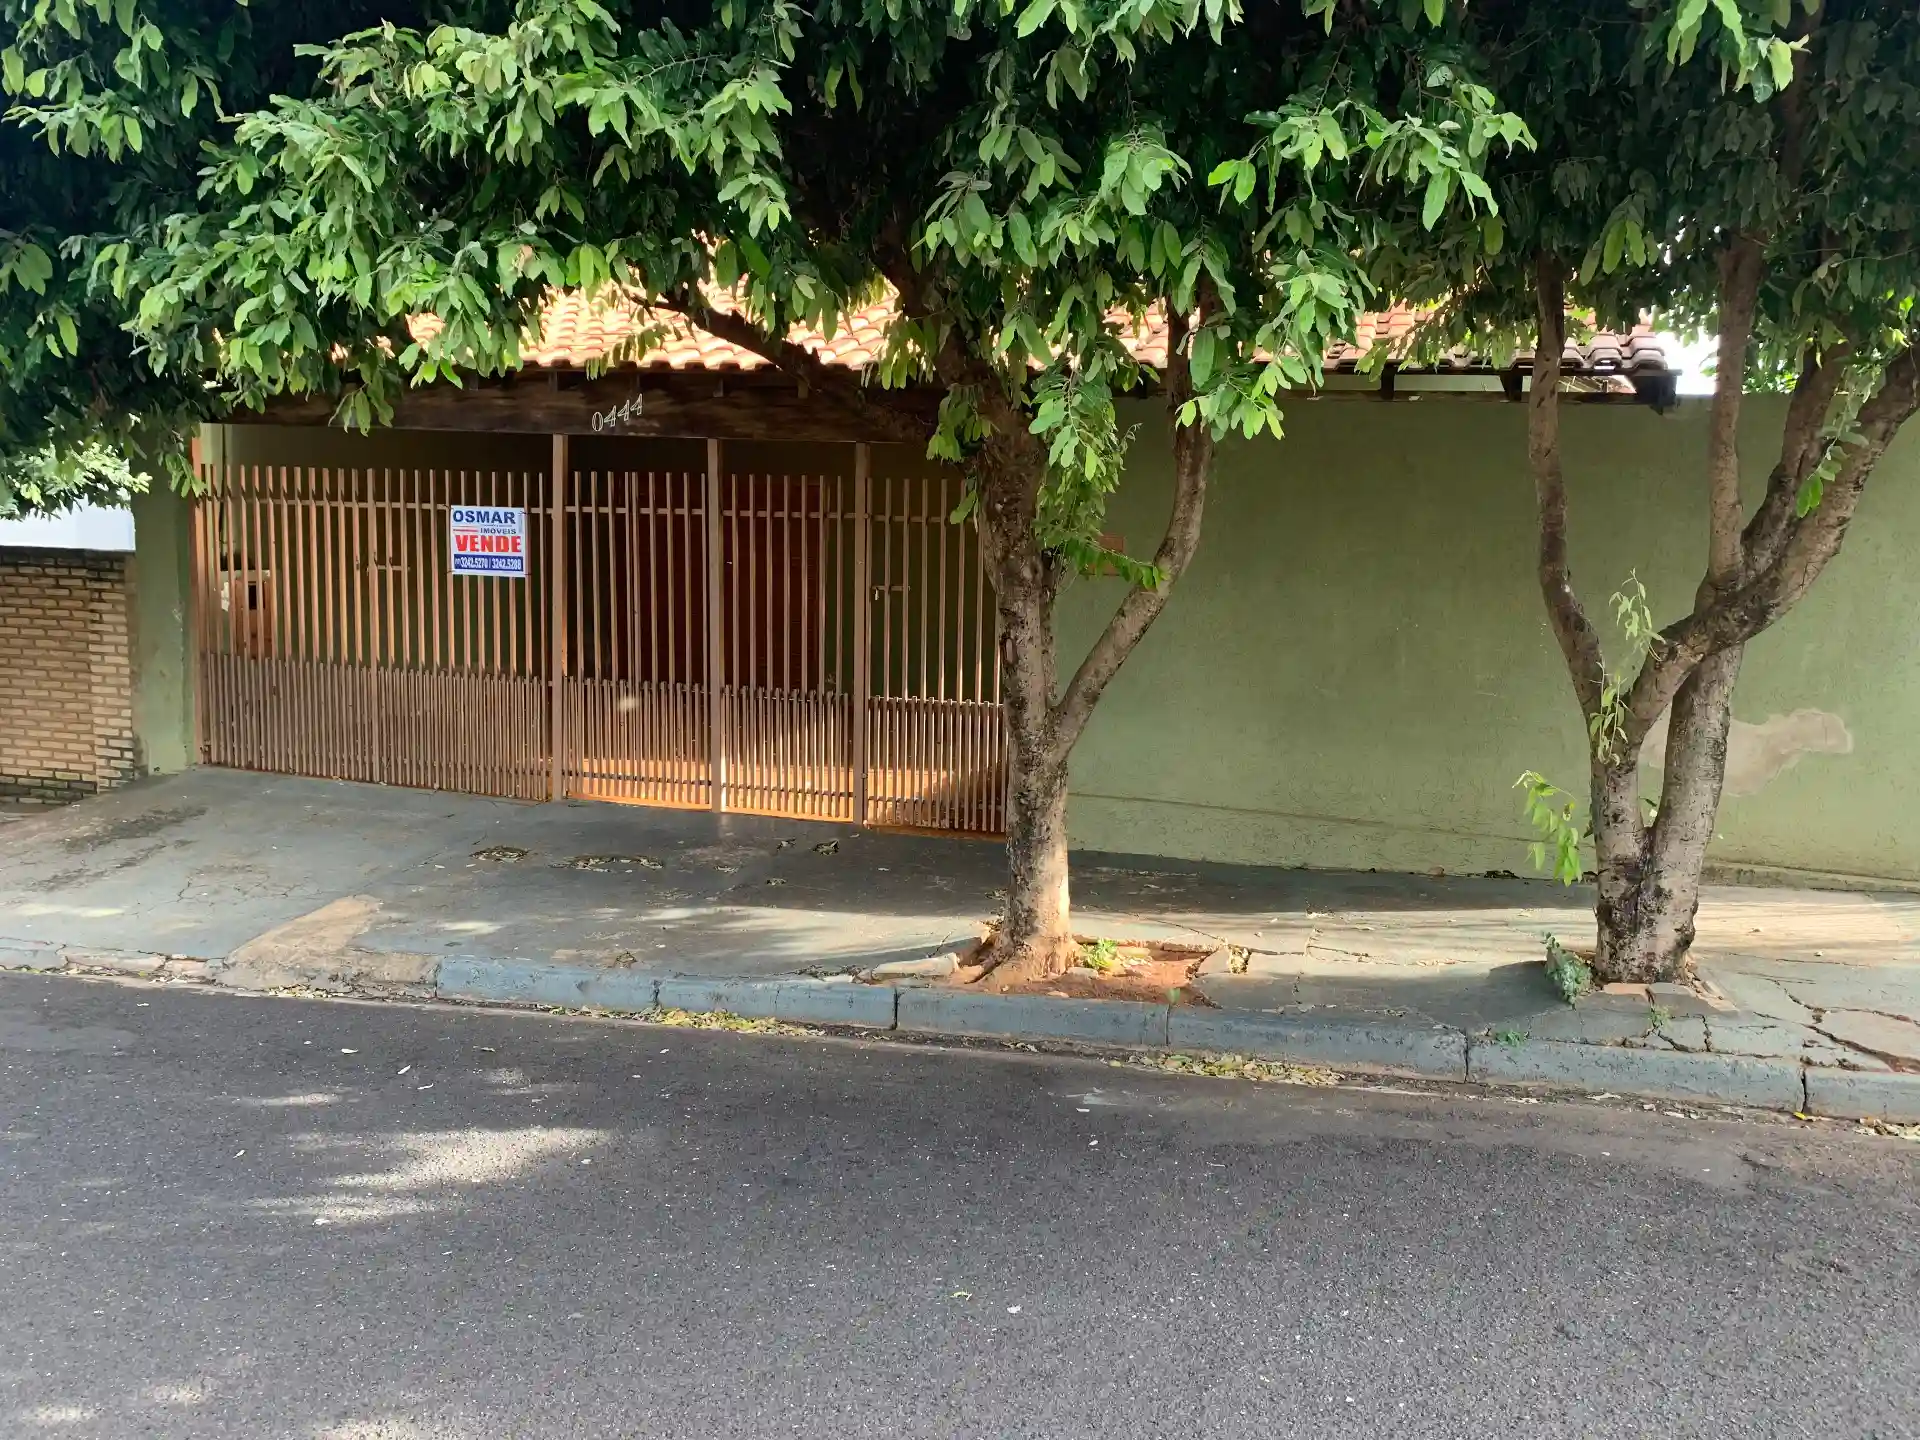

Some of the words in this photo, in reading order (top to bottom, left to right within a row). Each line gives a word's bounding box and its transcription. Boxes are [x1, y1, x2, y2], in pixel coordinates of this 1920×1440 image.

[592, 393, 643, 431] 0444
[453, 510, 516, 524] OSMAR
[455, 535, 521, 552] VENDE
